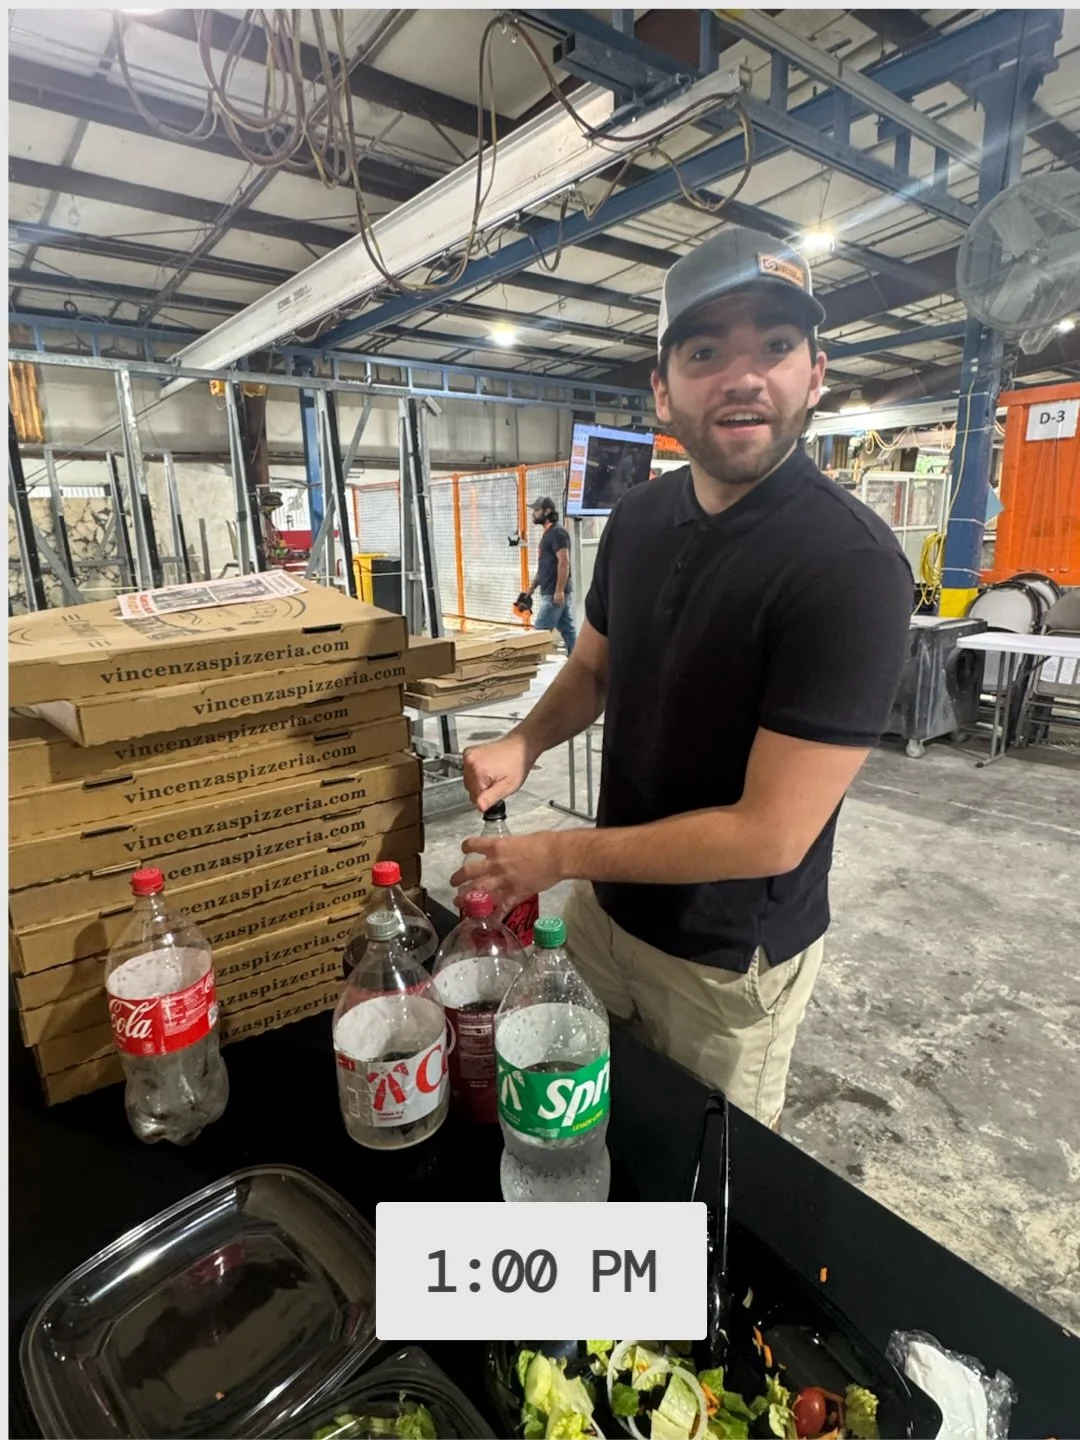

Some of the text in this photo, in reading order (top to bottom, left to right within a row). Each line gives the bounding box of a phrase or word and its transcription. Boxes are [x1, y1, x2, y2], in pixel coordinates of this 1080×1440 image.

[1039, 410, 1066, 425] D-3
[100, 638, 350, 685] vincenzaspizzeria.com
[193, 664, 407, 715] vincenzaspizzeria.com
[115, 706, 349, 761] vincenzaspizzeria.com
[124, 743, 357, 804] vincenzaspizzeria.com
[123, 786, 367, 853] vincenzaspizzeria.com
[167, 819, 367, 881] cenzaspizzeria.com
[180, 852, 371, 916] cenzaspizzeria.com
[206, 887, 367, 945] zaspizzeria.com
[217, 927, 351, 978] zaspizzeria.c
